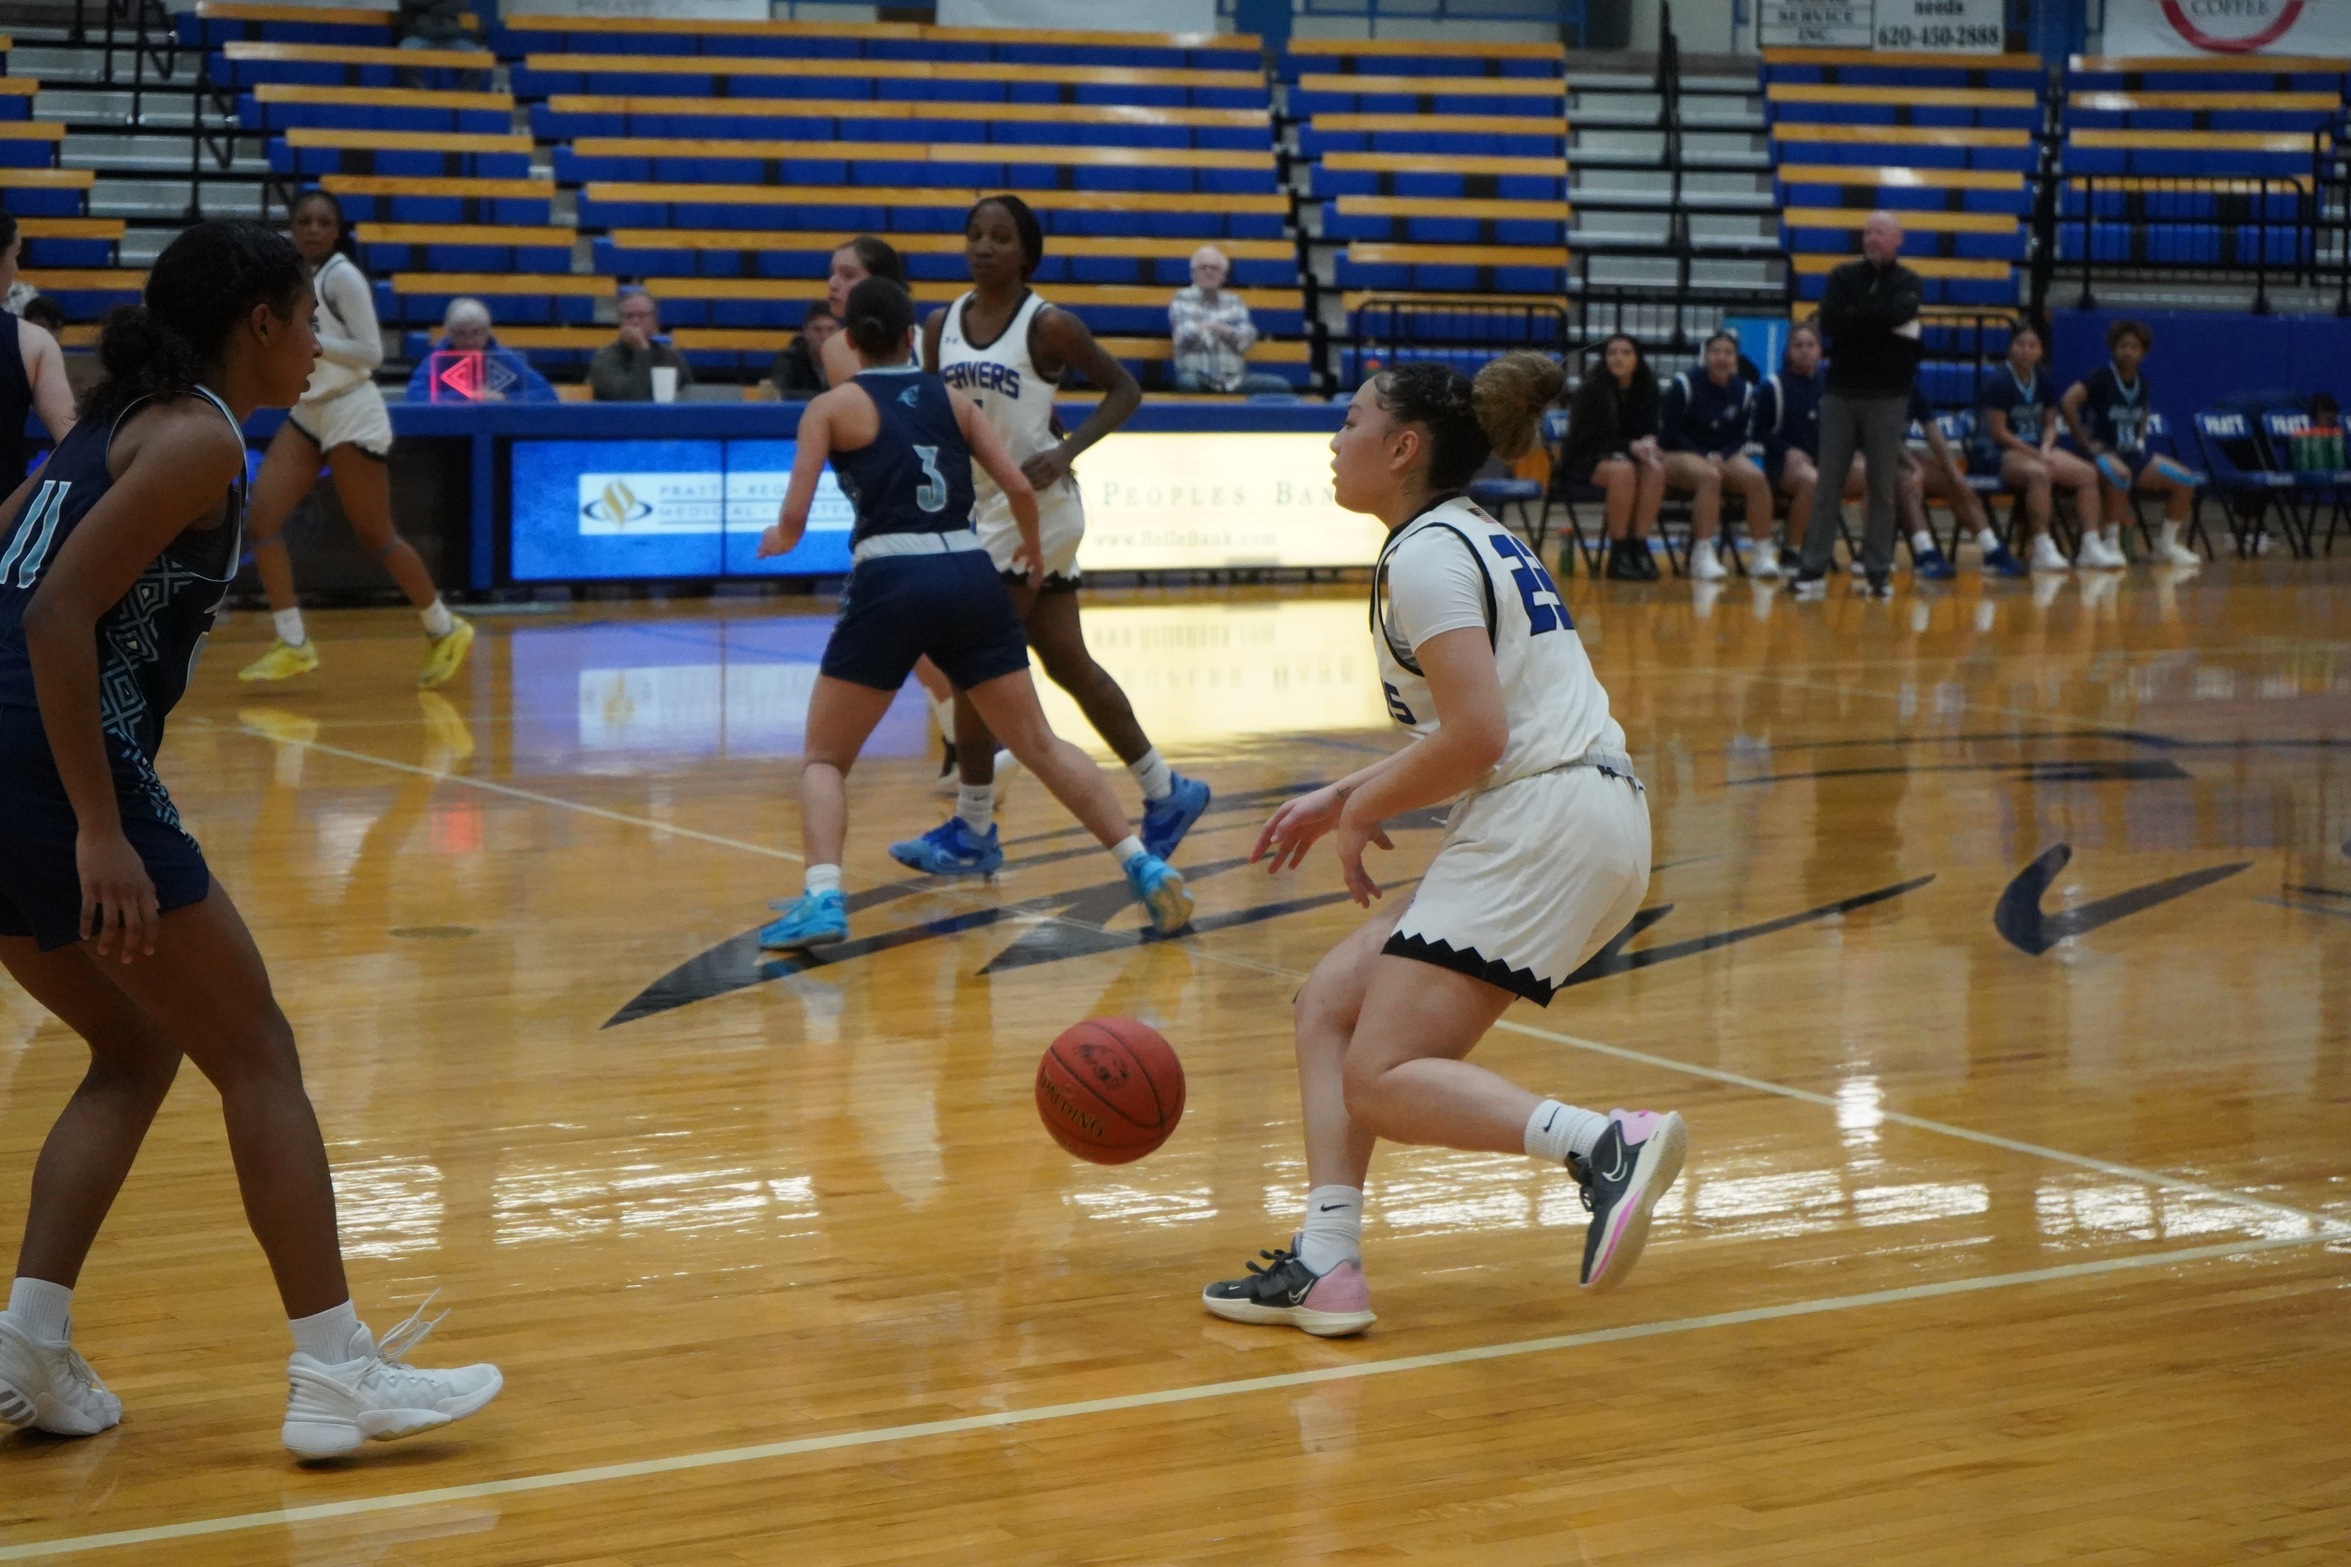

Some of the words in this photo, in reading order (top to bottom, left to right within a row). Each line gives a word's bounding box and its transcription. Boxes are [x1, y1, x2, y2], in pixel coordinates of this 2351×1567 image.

[1778, 8, 1854, 23] SERVICE
[1913, 0, 1964, 15] needs
[2190, 0, 2269, 16] COFFEE
[1877, 24, 1999, 47] 620-450-2888
[945, 361, 1020, 400] EAVERS
[912, 444, 947, 513] 3
[1275, 480, 1335, 505] BAN
[0, 479, 72, 589] 11
